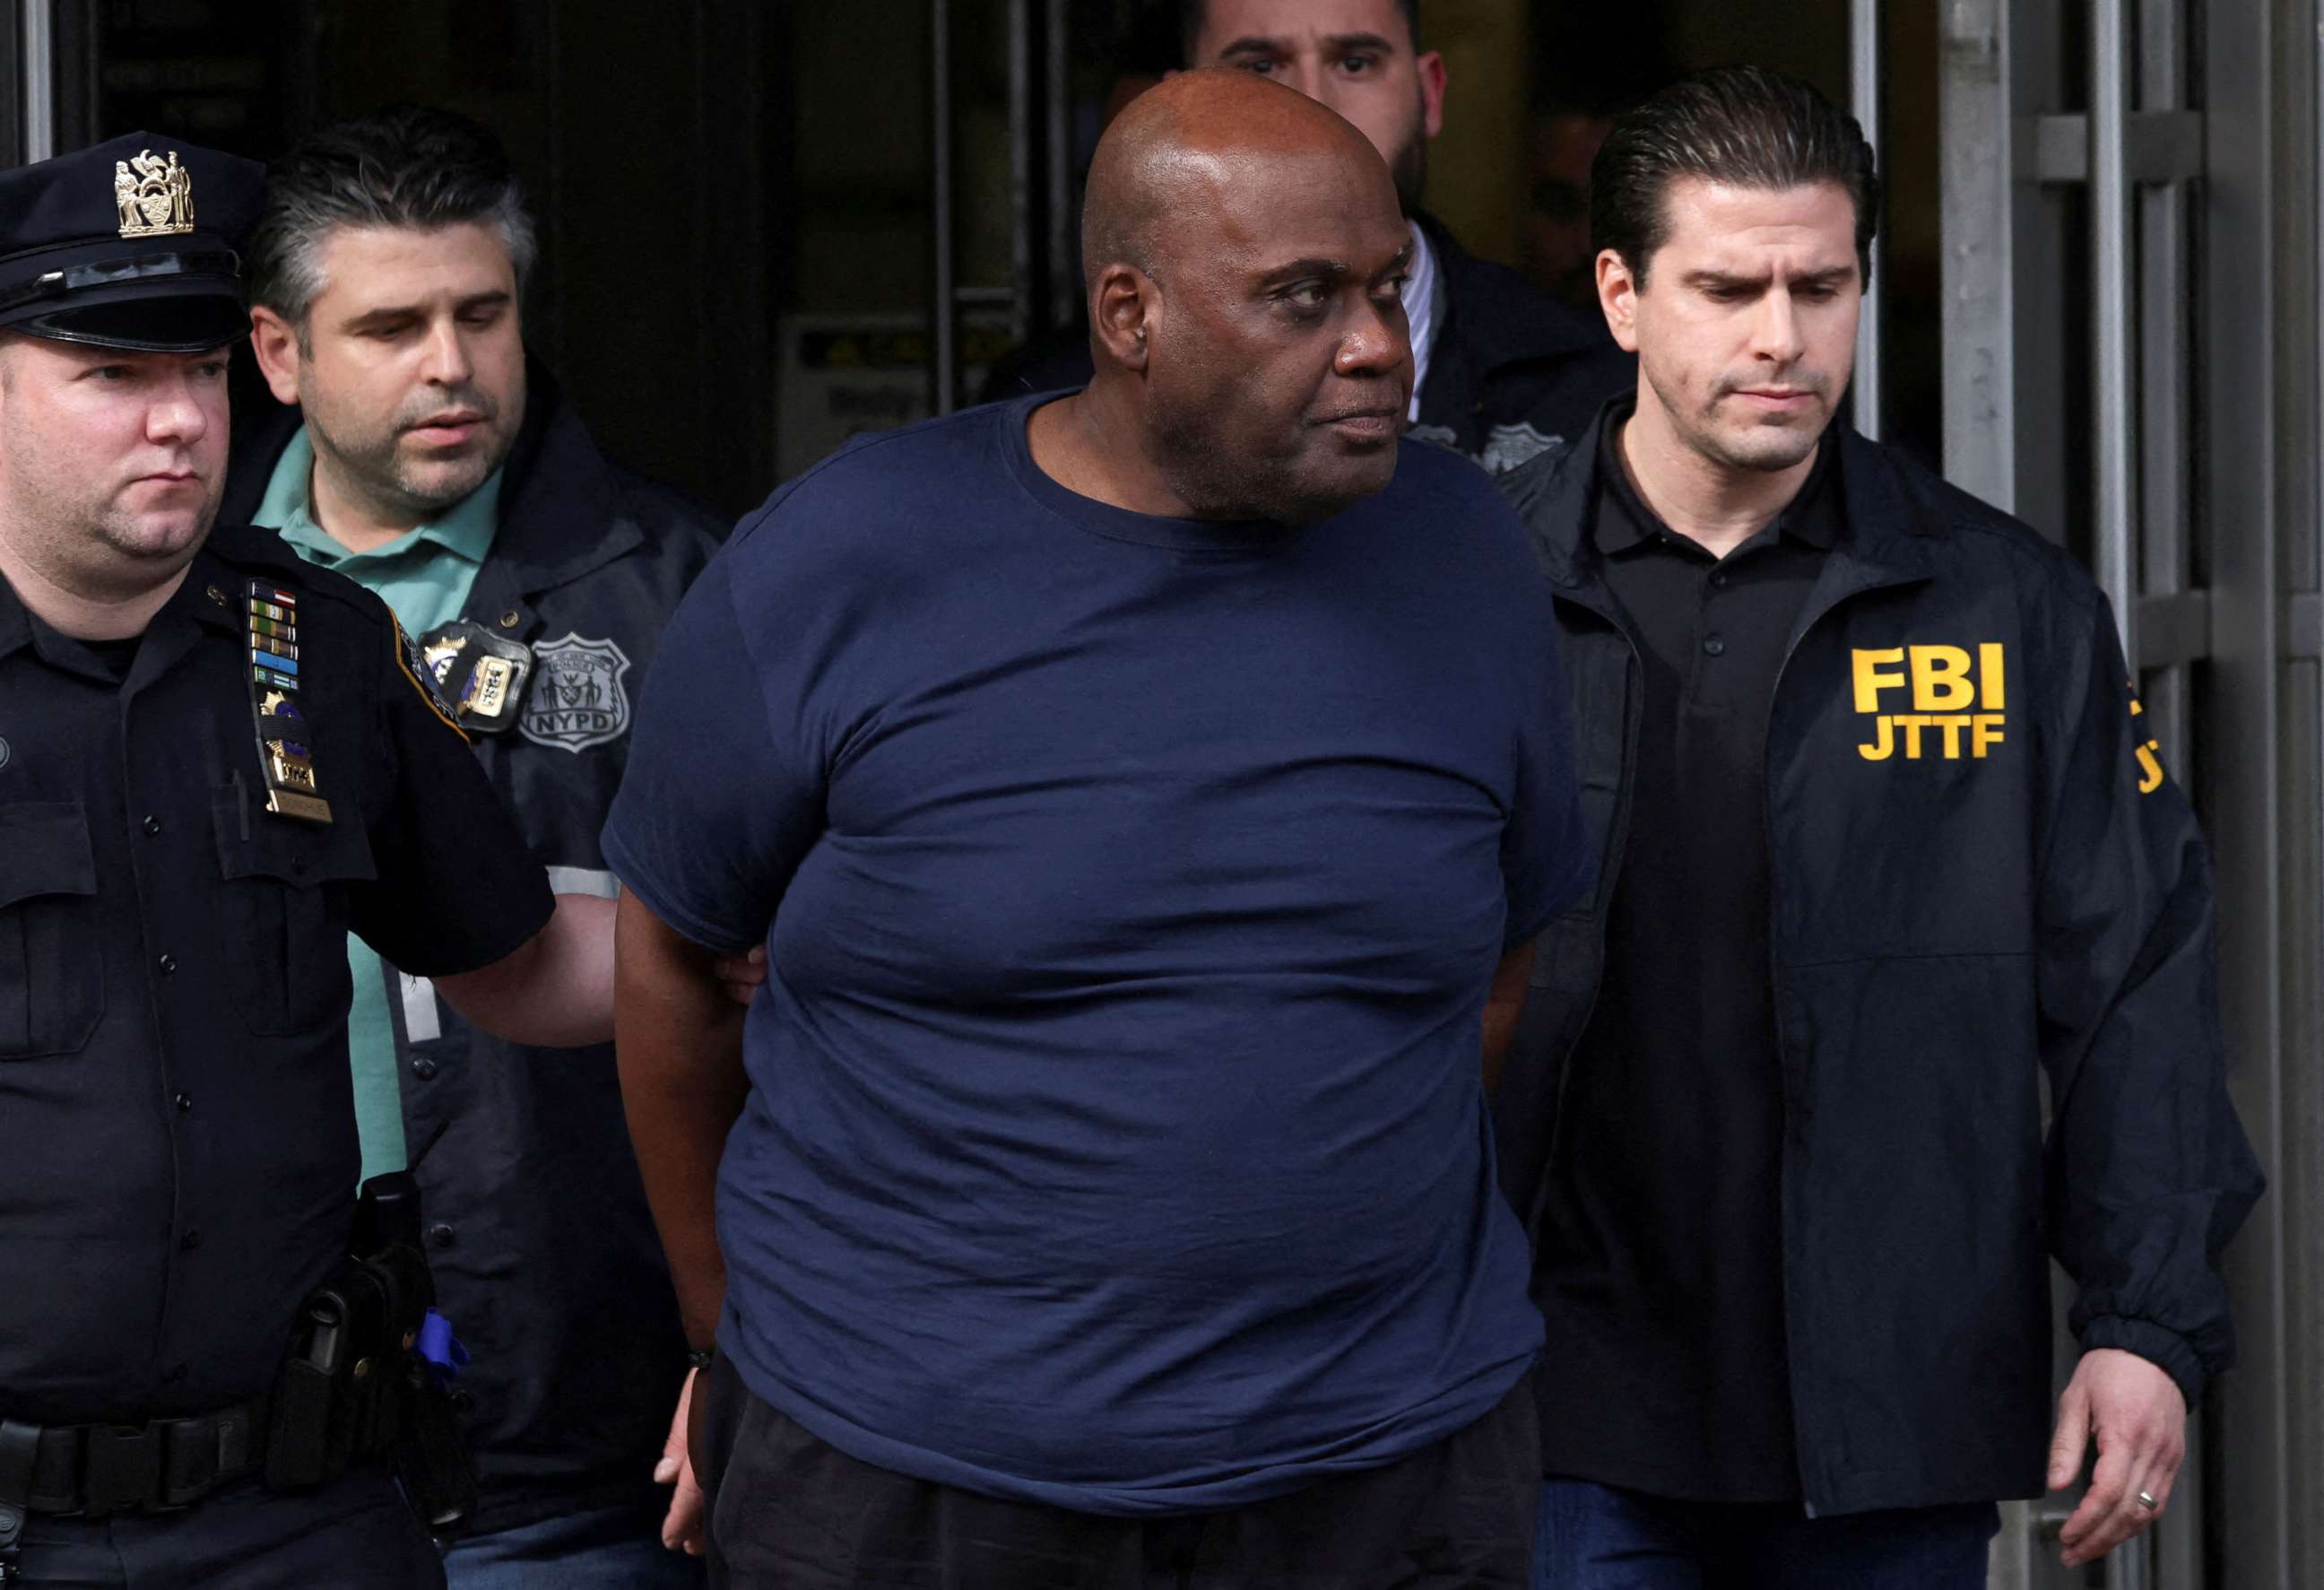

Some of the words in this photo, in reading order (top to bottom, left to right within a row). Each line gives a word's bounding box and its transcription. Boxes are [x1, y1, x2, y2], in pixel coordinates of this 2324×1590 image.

[1851, 643, 2006, 714] FBI
[536, 713, 608, 733] NYPD
[1858, 714, 2006, 761] JTTF
